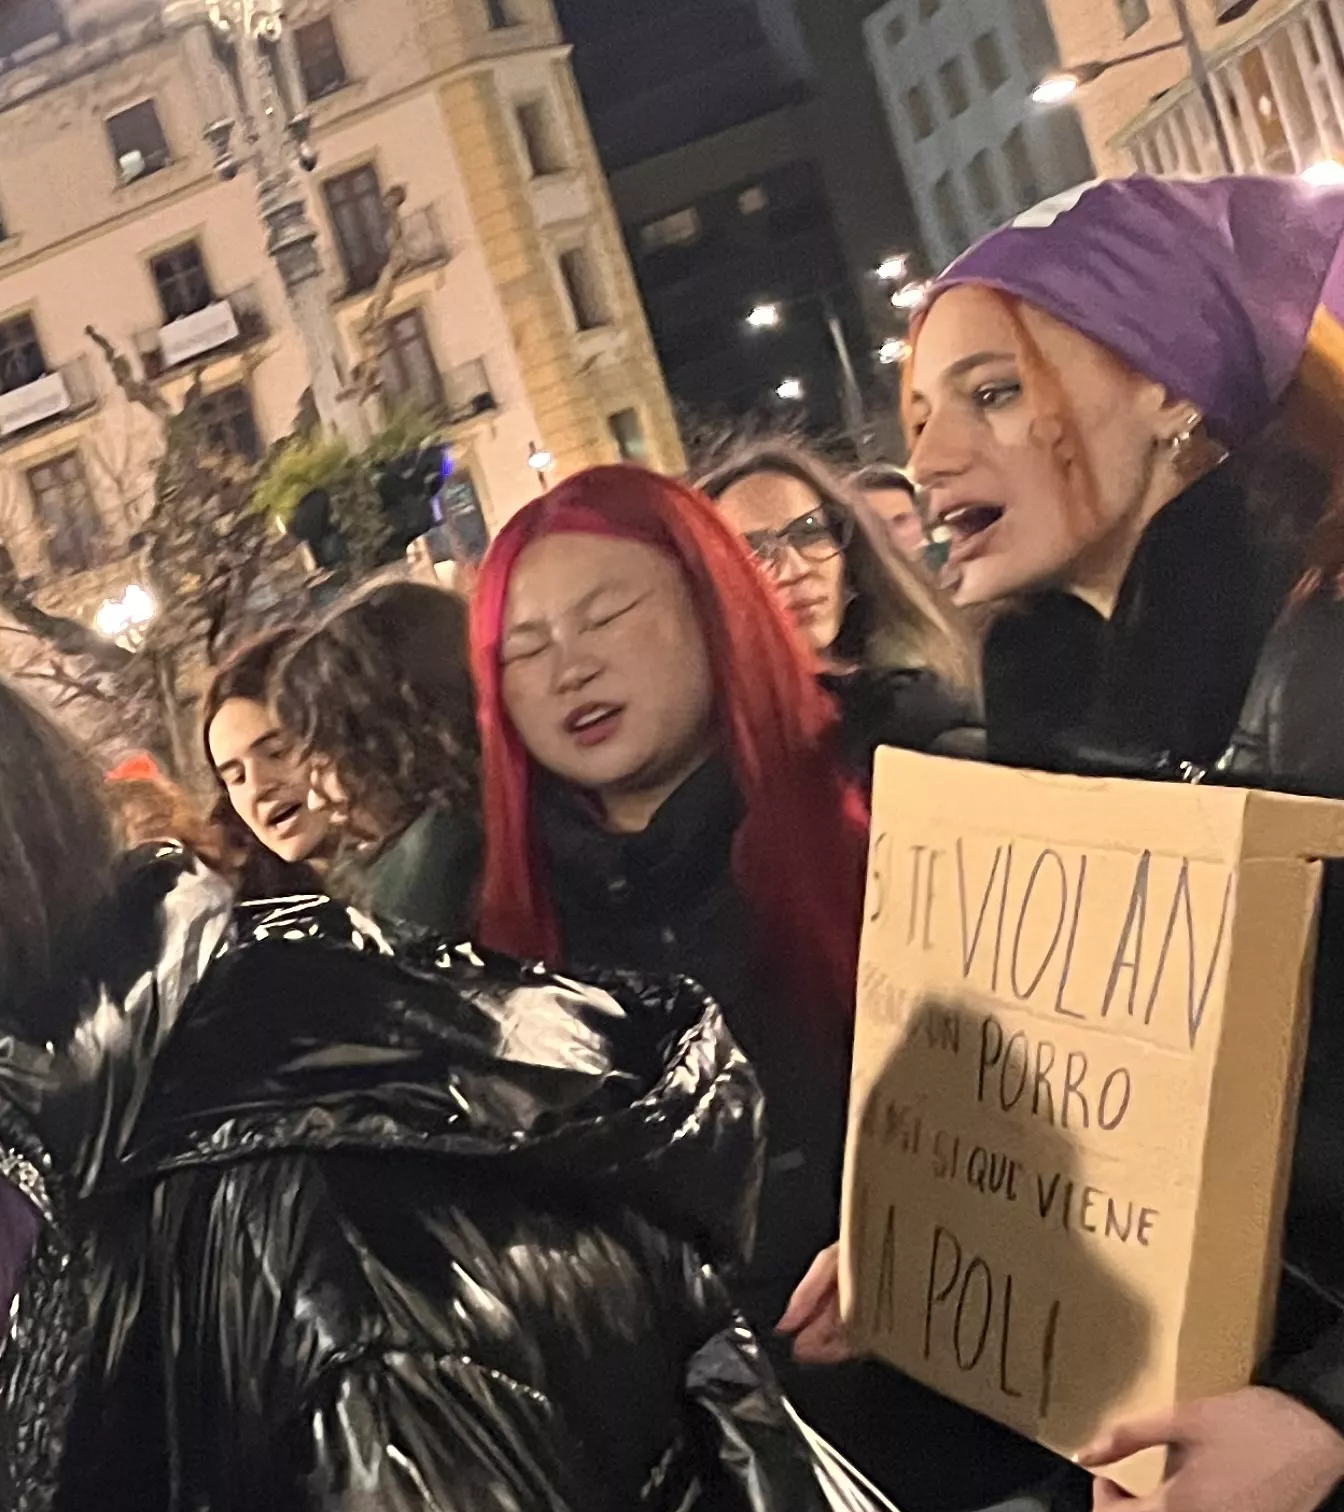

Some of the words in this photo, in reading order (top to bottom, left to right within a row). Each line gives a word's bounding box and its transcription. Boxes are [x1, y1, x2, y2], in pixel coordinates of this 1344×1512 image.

[906, 844, 947, 952] TE
[957, 836, 1234, 1049] VIOLAN
[977, 1013, 1132, 1131] PORRO
[967, 1145, 1023, 1202] QUE
[1036, 1172, 1161, 1248] VIENE
[923, 1224, 1062, 1419] POLI
